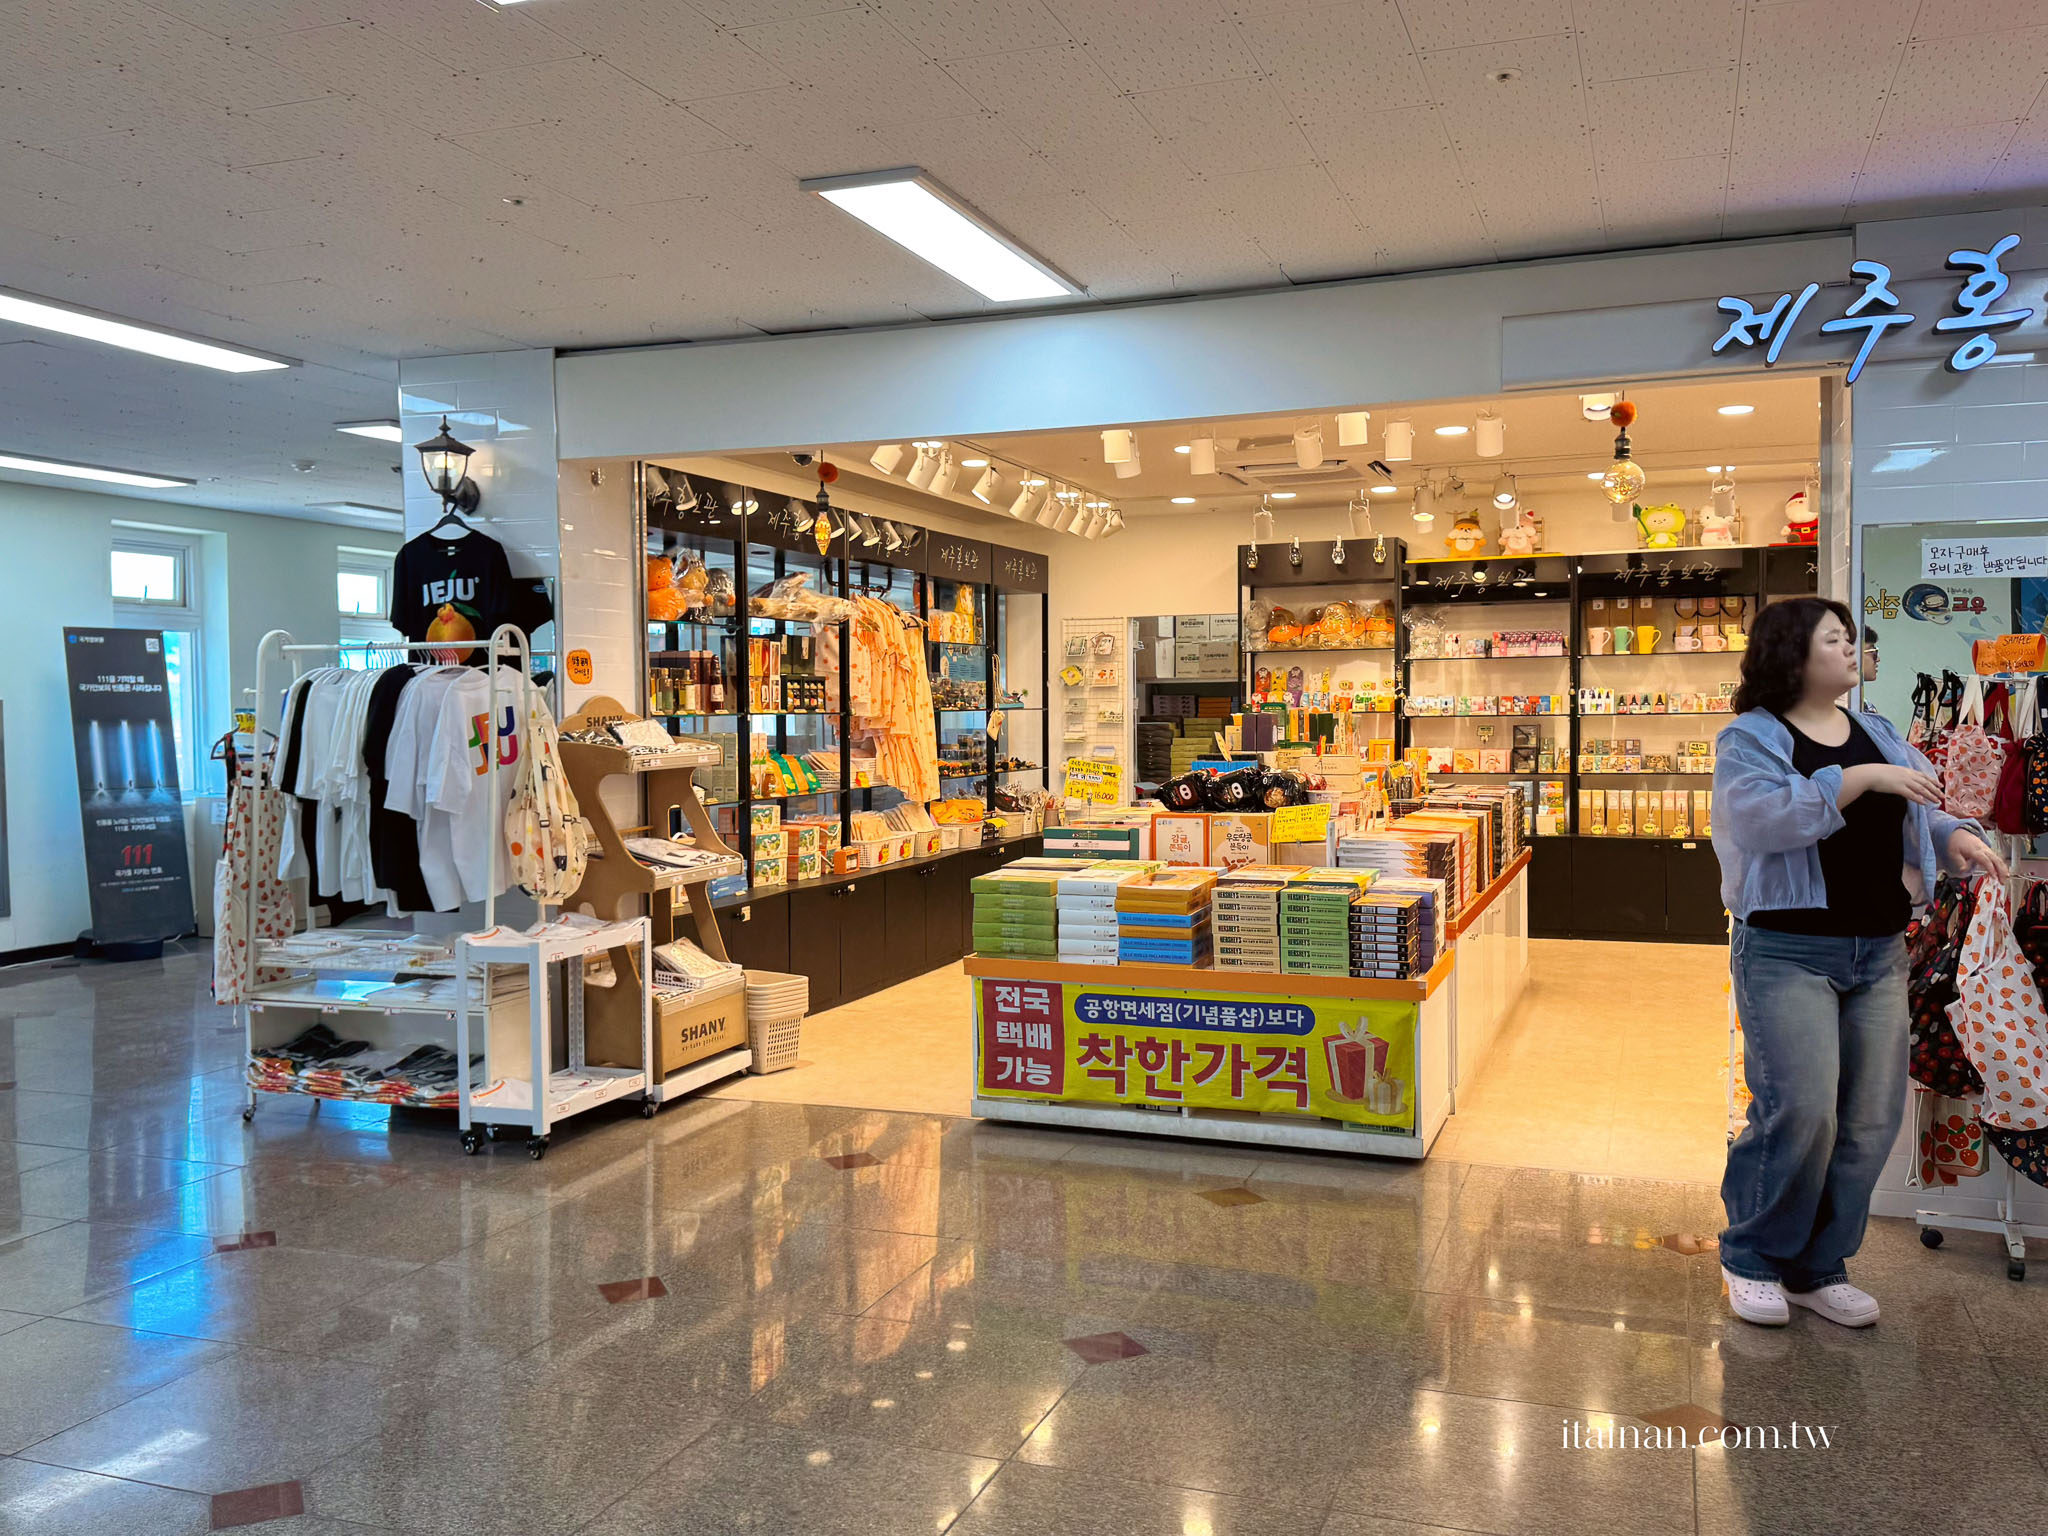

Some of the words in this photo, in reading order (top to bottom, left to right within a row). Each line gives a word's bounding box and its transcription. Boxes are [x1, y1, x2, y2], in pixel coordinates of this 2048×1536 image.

[1711, 234, 2048, 384] 제주홍
[941, 545, 979, 571] 제주홍보관
[1005, 557, 1038, 581] 제주홍보관
[1928, 563, 1950, 575] 우비
[1614, 560, 1721, 587] 제주홍보관
[423, 578, 475, 607] JEJU
[2002, 635, 2032, 646] SAMPLE
[1226, 832, 1253, 843] 우도땅콩
[121, 843, 153, 867] 111
[995, 985, 1050, 1014] 전국
[681, 1017, 726, 1043] SHANY
[996, 1021, 1052, 1050] 택배
[997, 1057, 1052, 1085] 가능
